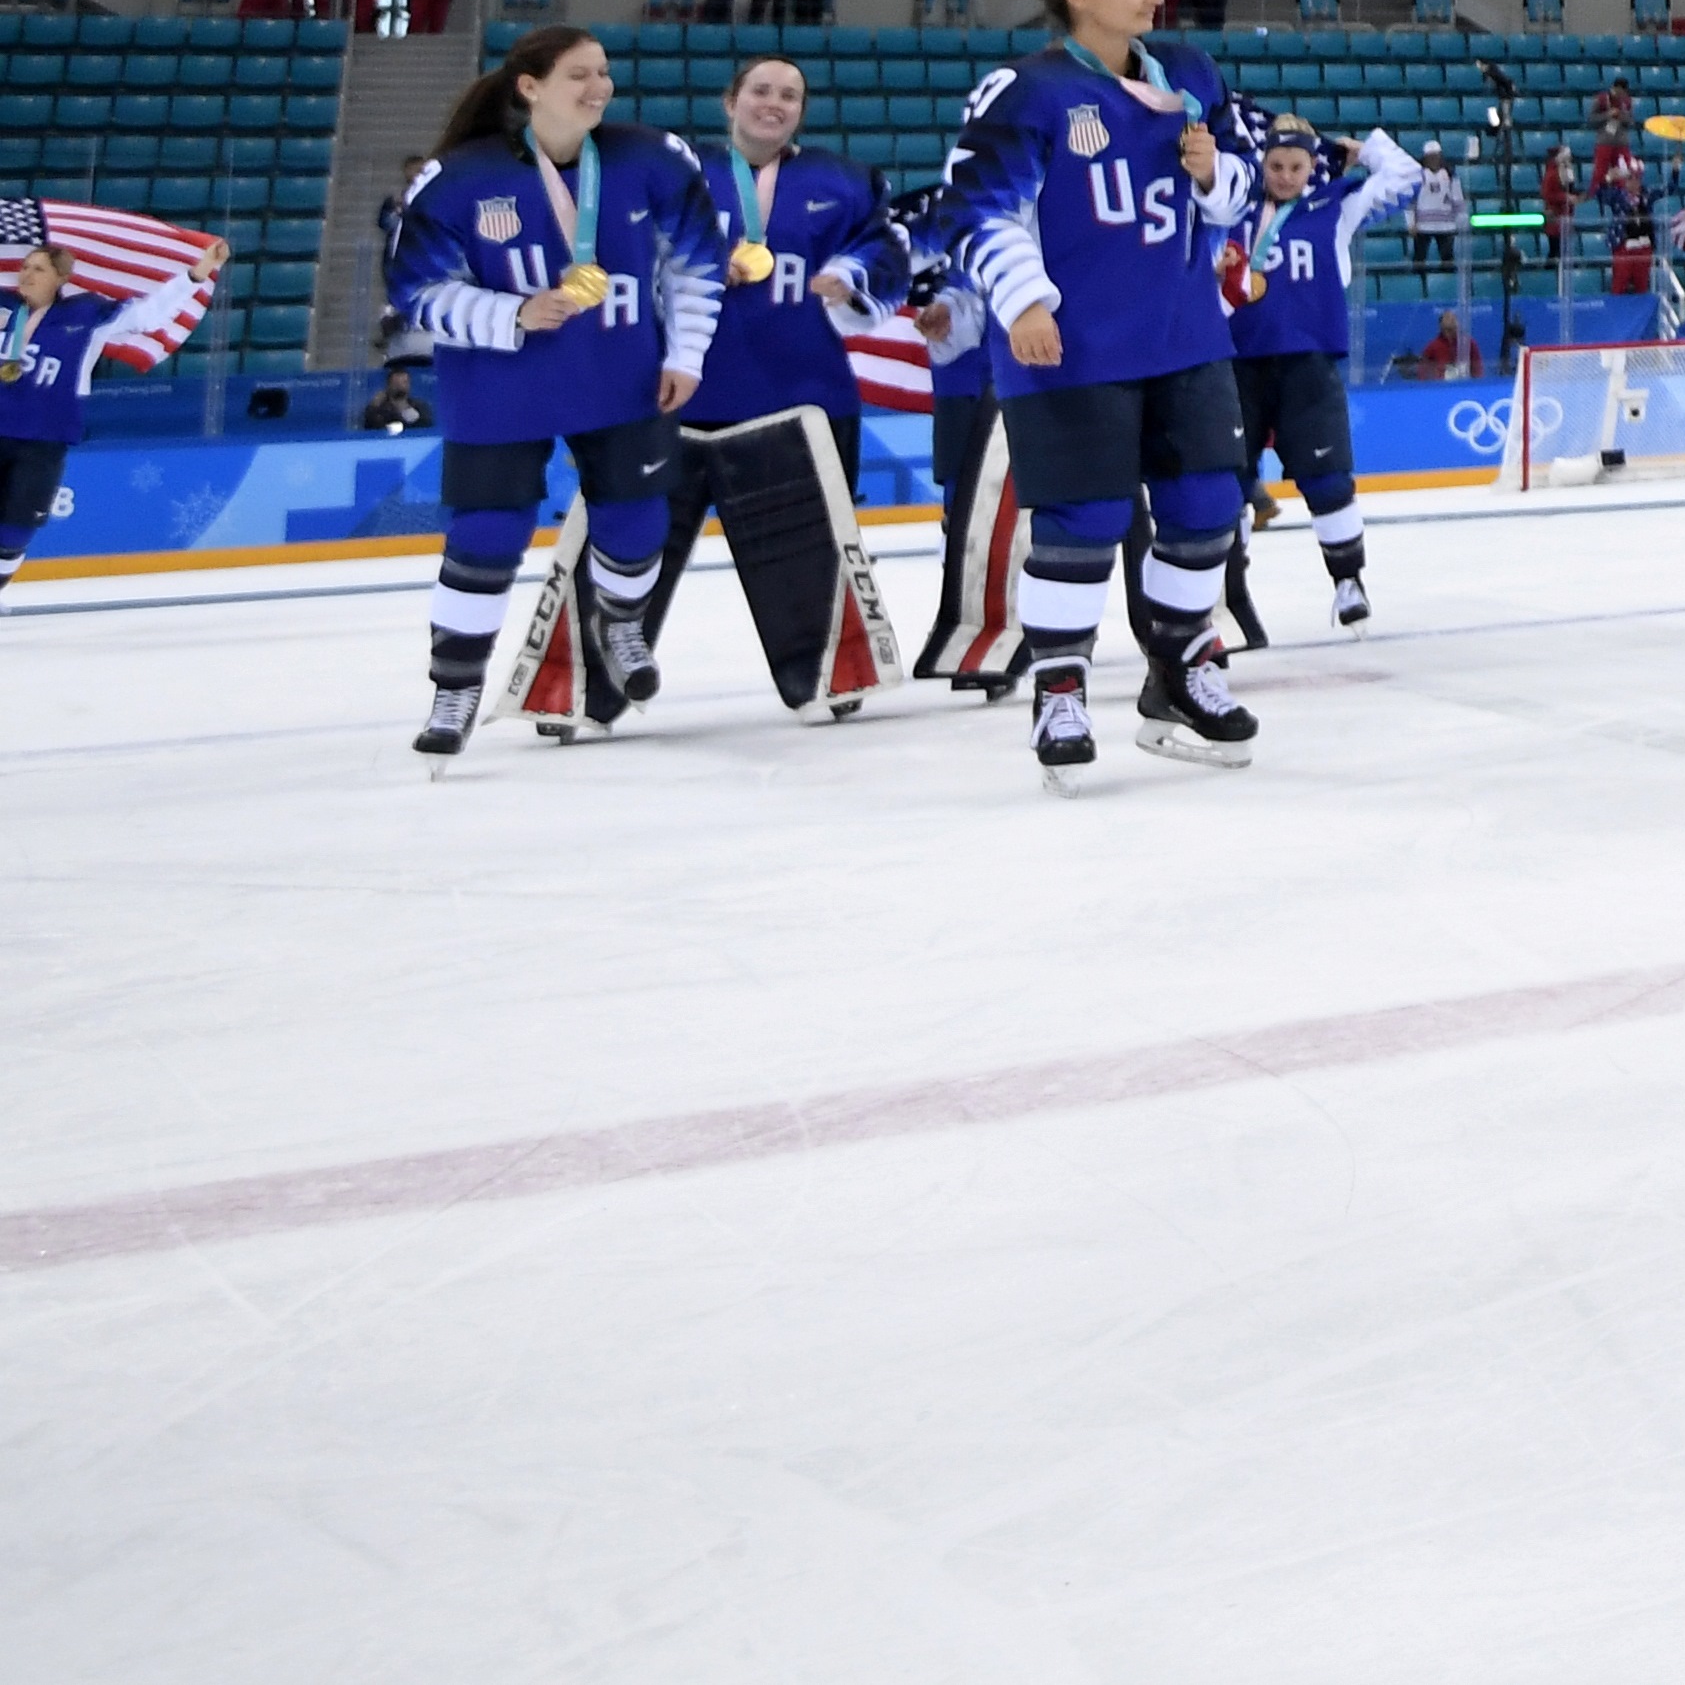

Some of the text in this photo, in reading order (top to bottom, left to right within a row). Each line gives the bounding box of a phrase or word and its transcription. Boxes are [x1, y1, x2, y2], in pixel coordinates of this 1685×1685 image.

[1089, 158, 1197, 265] US
[505, 243, 640, 329] UA
[527, 559, 568, 651] CCM
[844, 542, 885, 621] CCM
